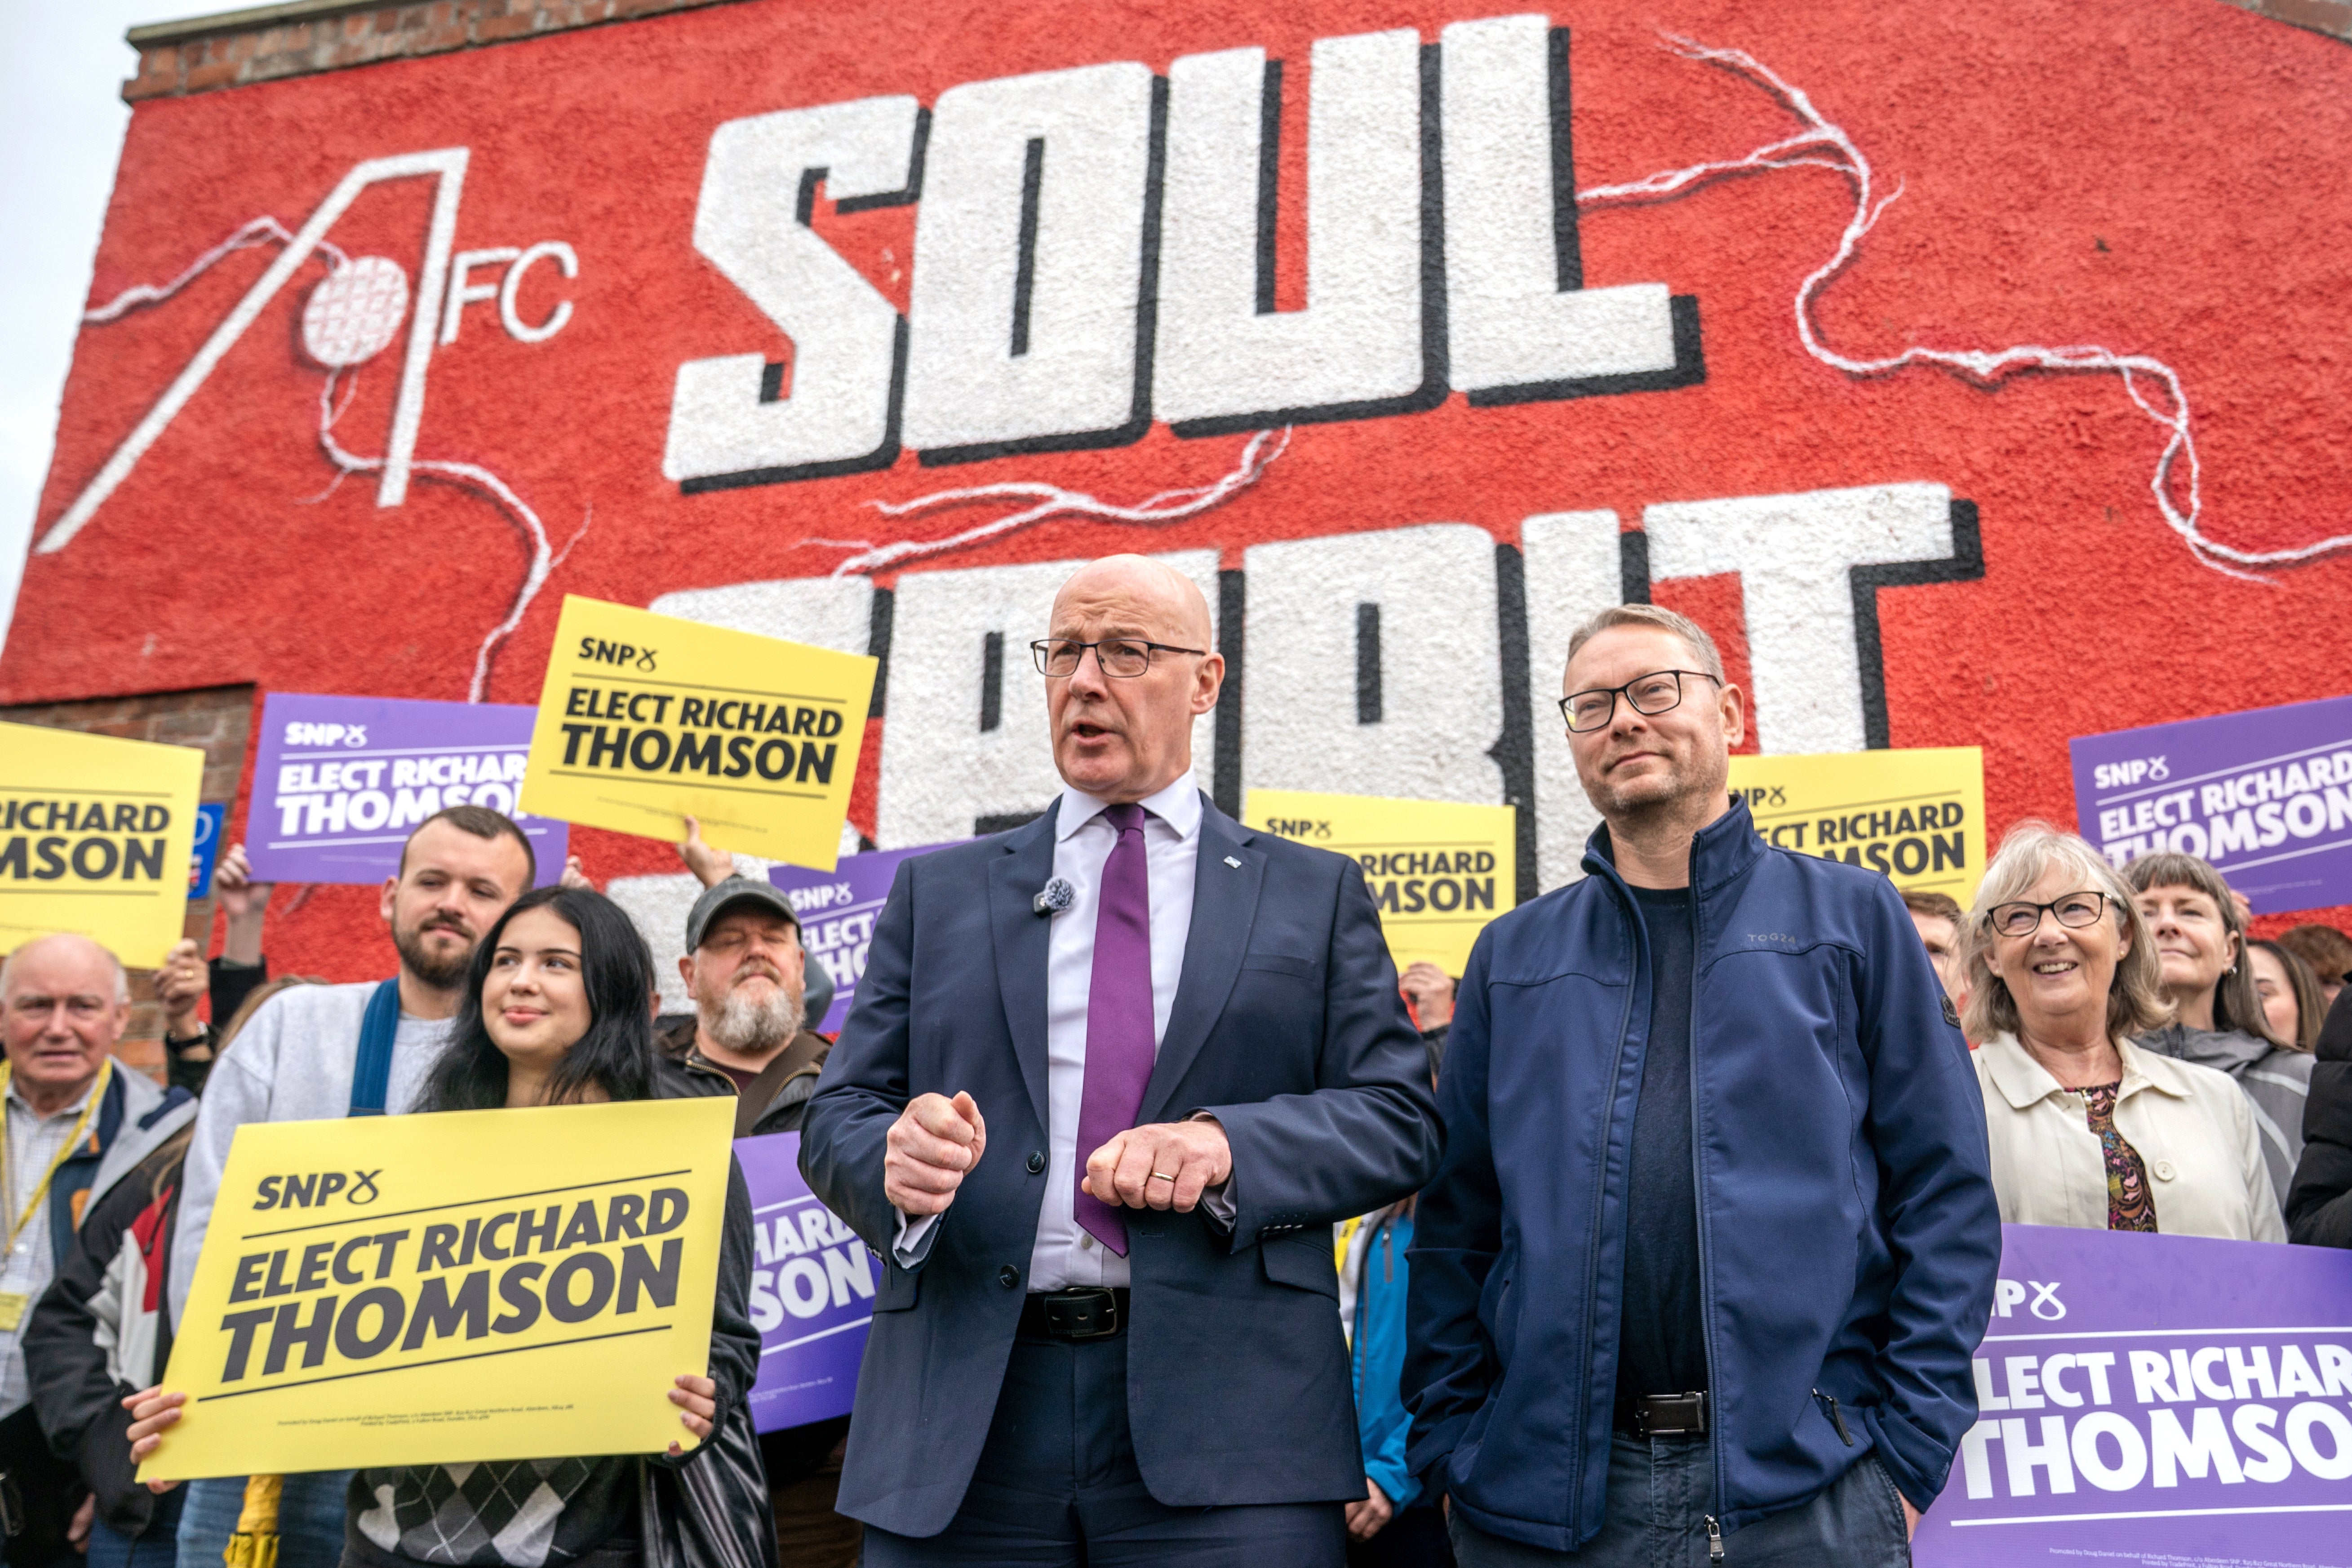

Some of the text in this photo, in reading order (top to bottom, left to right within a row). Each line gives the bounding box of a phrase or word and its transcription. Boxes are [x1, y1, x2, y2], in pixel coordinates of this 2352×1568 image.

[663, 13, 1705, 490] SOUL
[578, 637, 636, 667] SNP
[565, 687, 843, 738] ELECT RICHARD
[284, 721, 345, 746] SNP
[562, 724, 838, 784] THOMSON
[277, 759, 388, 794] ELECT
[2094, 759, 2149, 788] SNP
[0, 800, 170, 833] ICHARD
[1267, 817, 1312, 836] SNP
[1817, 802, 1964, 845] RICHARD
[2099, 789, 2195, 842] ELECT
[1359, 850, 1496, 876] RICHARD
[789, 884, 835, 912] SNP
[1747, 932, 1796, 944] TOG24
[252, 1172, 346, 1210] SNP
[228, 1187, 691, 1304] ELECT RICHARD
[220, 1237, 683, 1383] THOMSON
